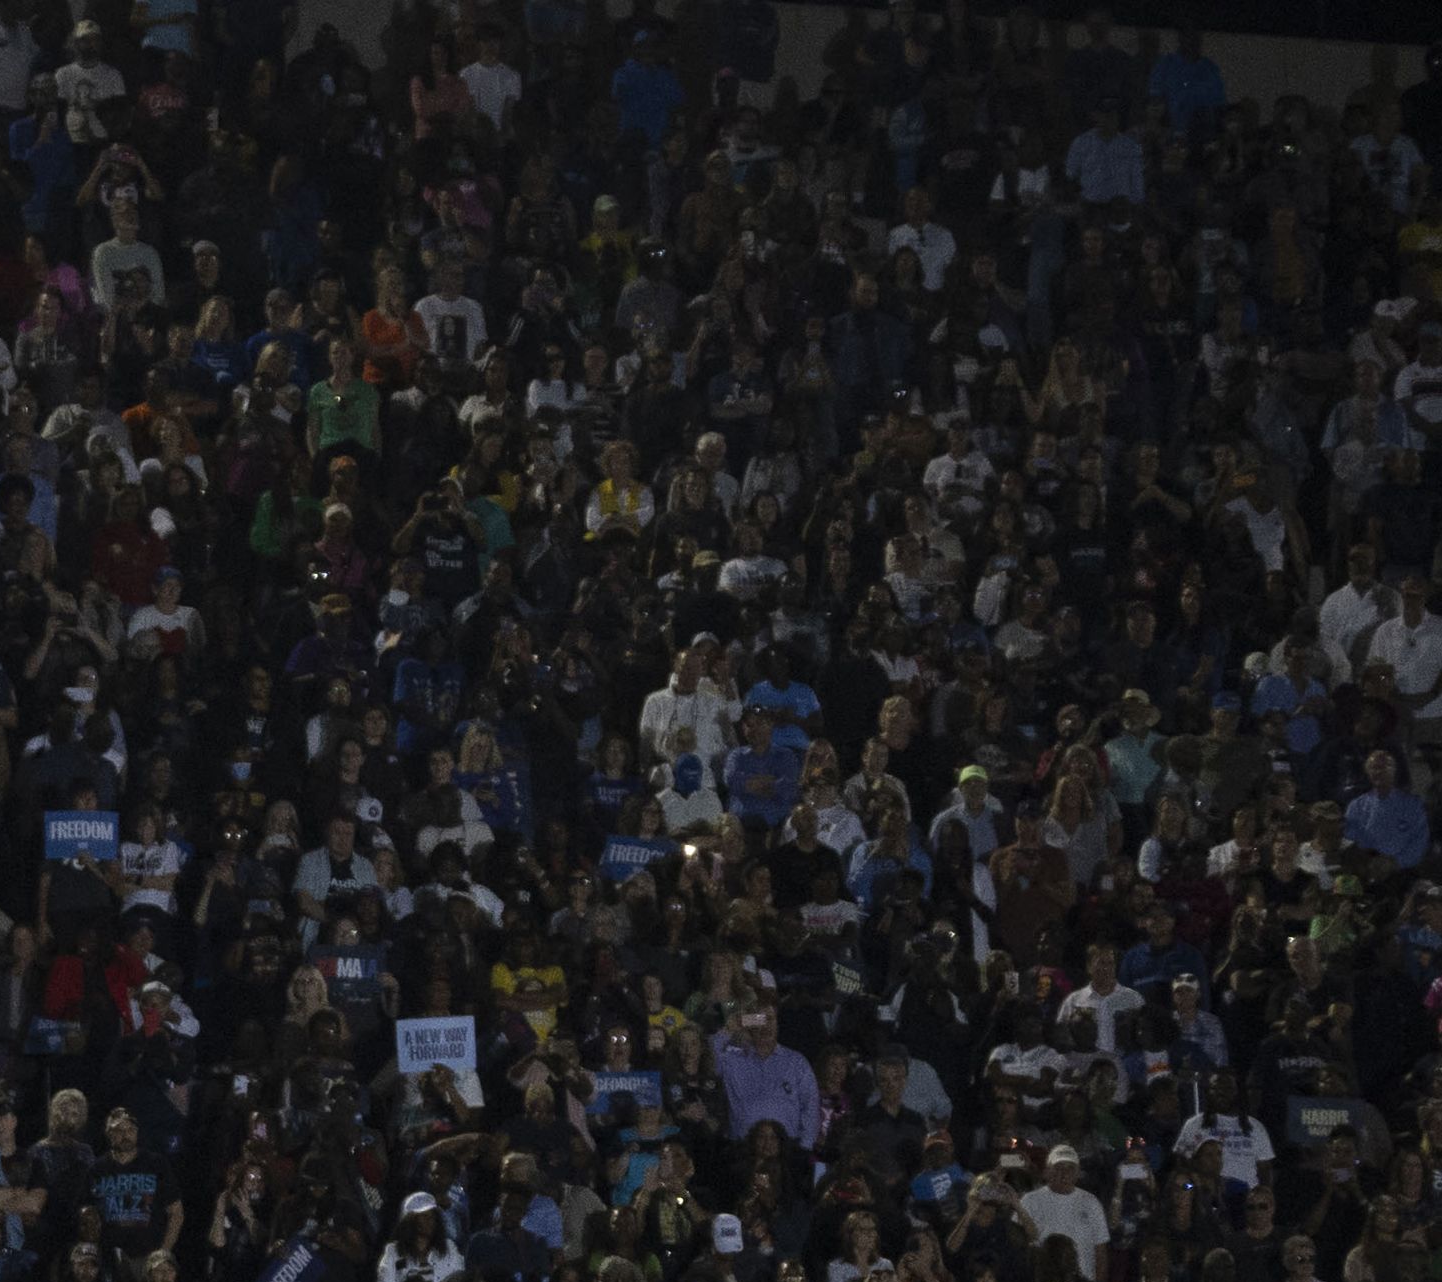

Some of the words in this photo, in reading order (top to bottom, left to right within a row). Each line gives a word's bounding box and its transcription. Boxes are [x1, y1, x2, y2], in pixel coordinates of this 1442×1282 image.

[50, 822, 114, 841] FREEDOM
[416, 1031, 441, 1045] NEW
[446, 1028, 469, 1045] WAY
[408, 1045, 466, 1063] FORWARD
